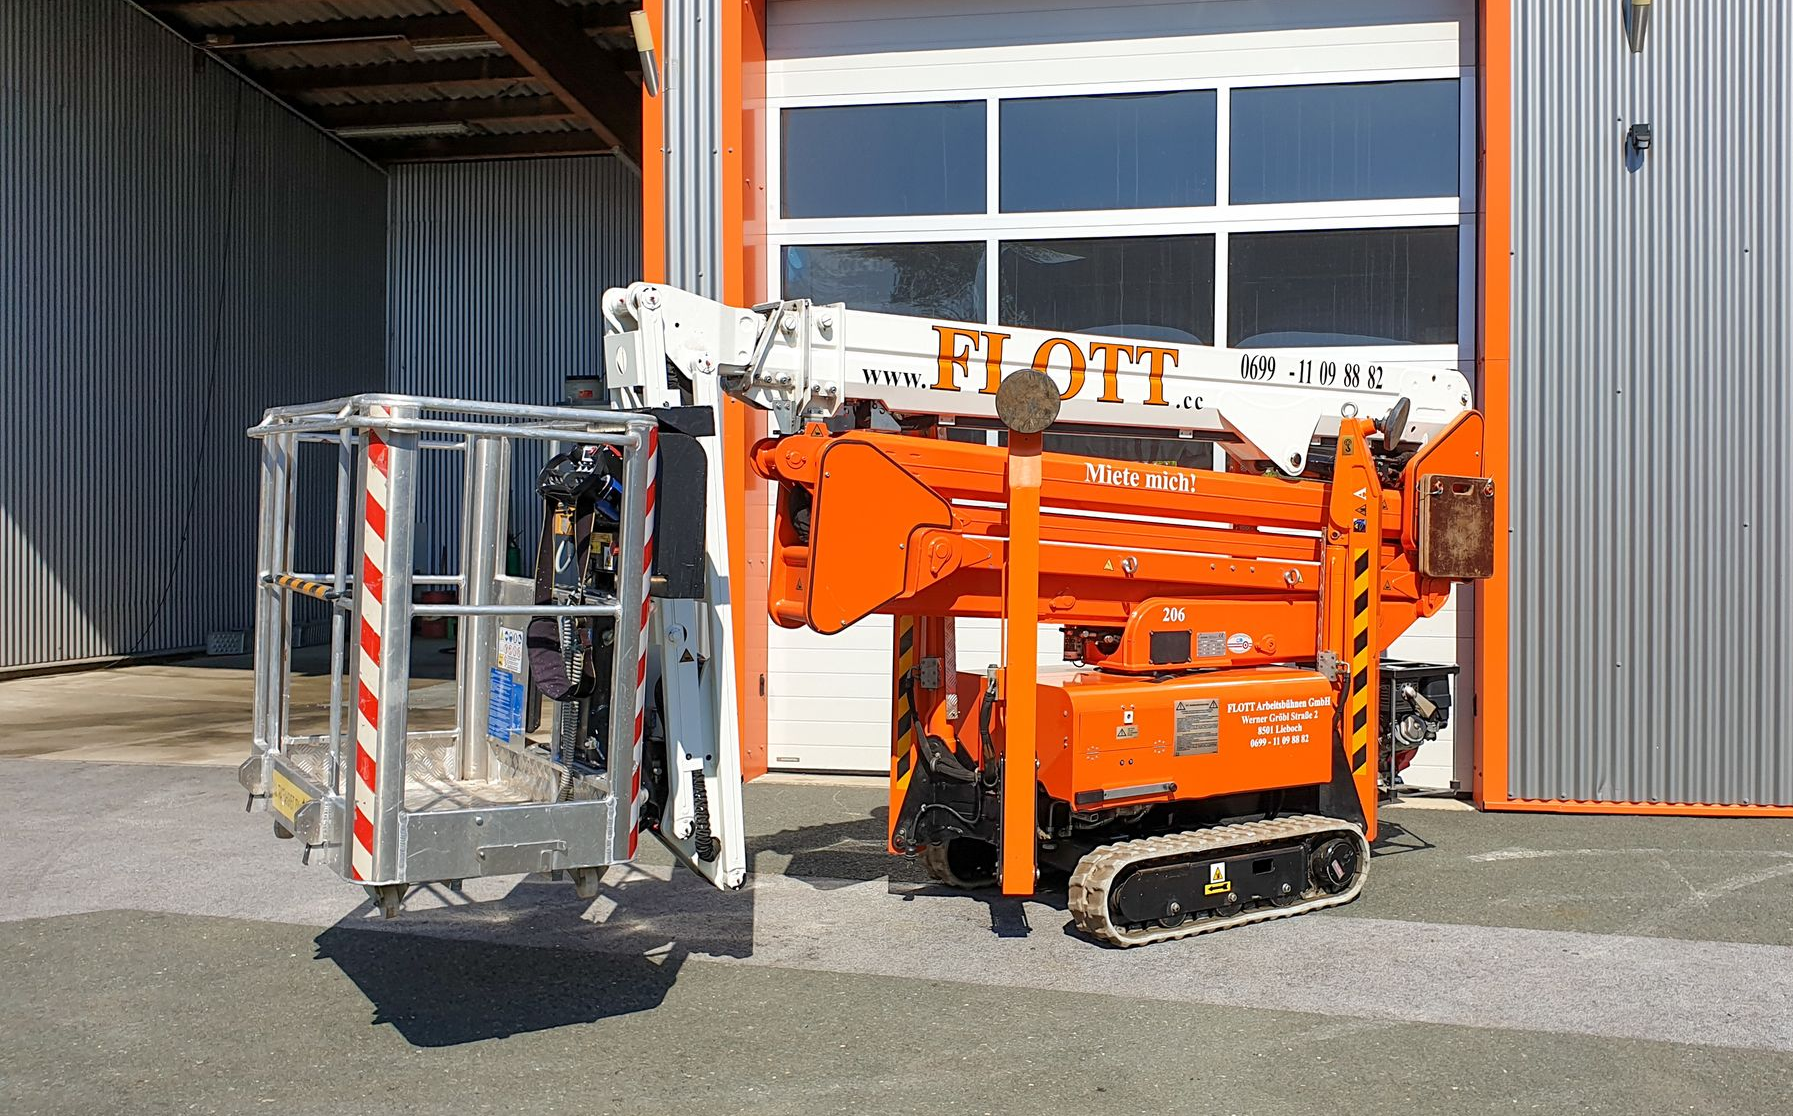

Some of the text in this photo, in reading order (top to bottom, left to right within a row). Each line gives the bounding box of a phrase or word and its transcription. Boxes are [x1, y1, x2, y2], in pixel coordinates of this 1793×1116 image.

[1240, 353, 1276, 381] 0699
[1320, 361, 1336, 386] 09
[1344, 363, 1360, 388] 88
[1367, 365, 1383, 389] 82
[1084, 462, 1197, 493] Miete mich!
[1162, 606, 1186, 623] 206
[1227, 696, 1331, 713] FLOTT Arbeitsbühnen GmbH
[1241, 710, 1319, 724] Werner Gröbl Straße 2
[1257, 723, 1303, 735] 8501 Lieboch
[1250, 738, 1267, 748] 0699
[1273, 736, 1280, 746] 11
[1281, 736, 1290, 745] 09
[1291, 735, 1300, 744] 88
[1300, 734, 1309, 743] 82
